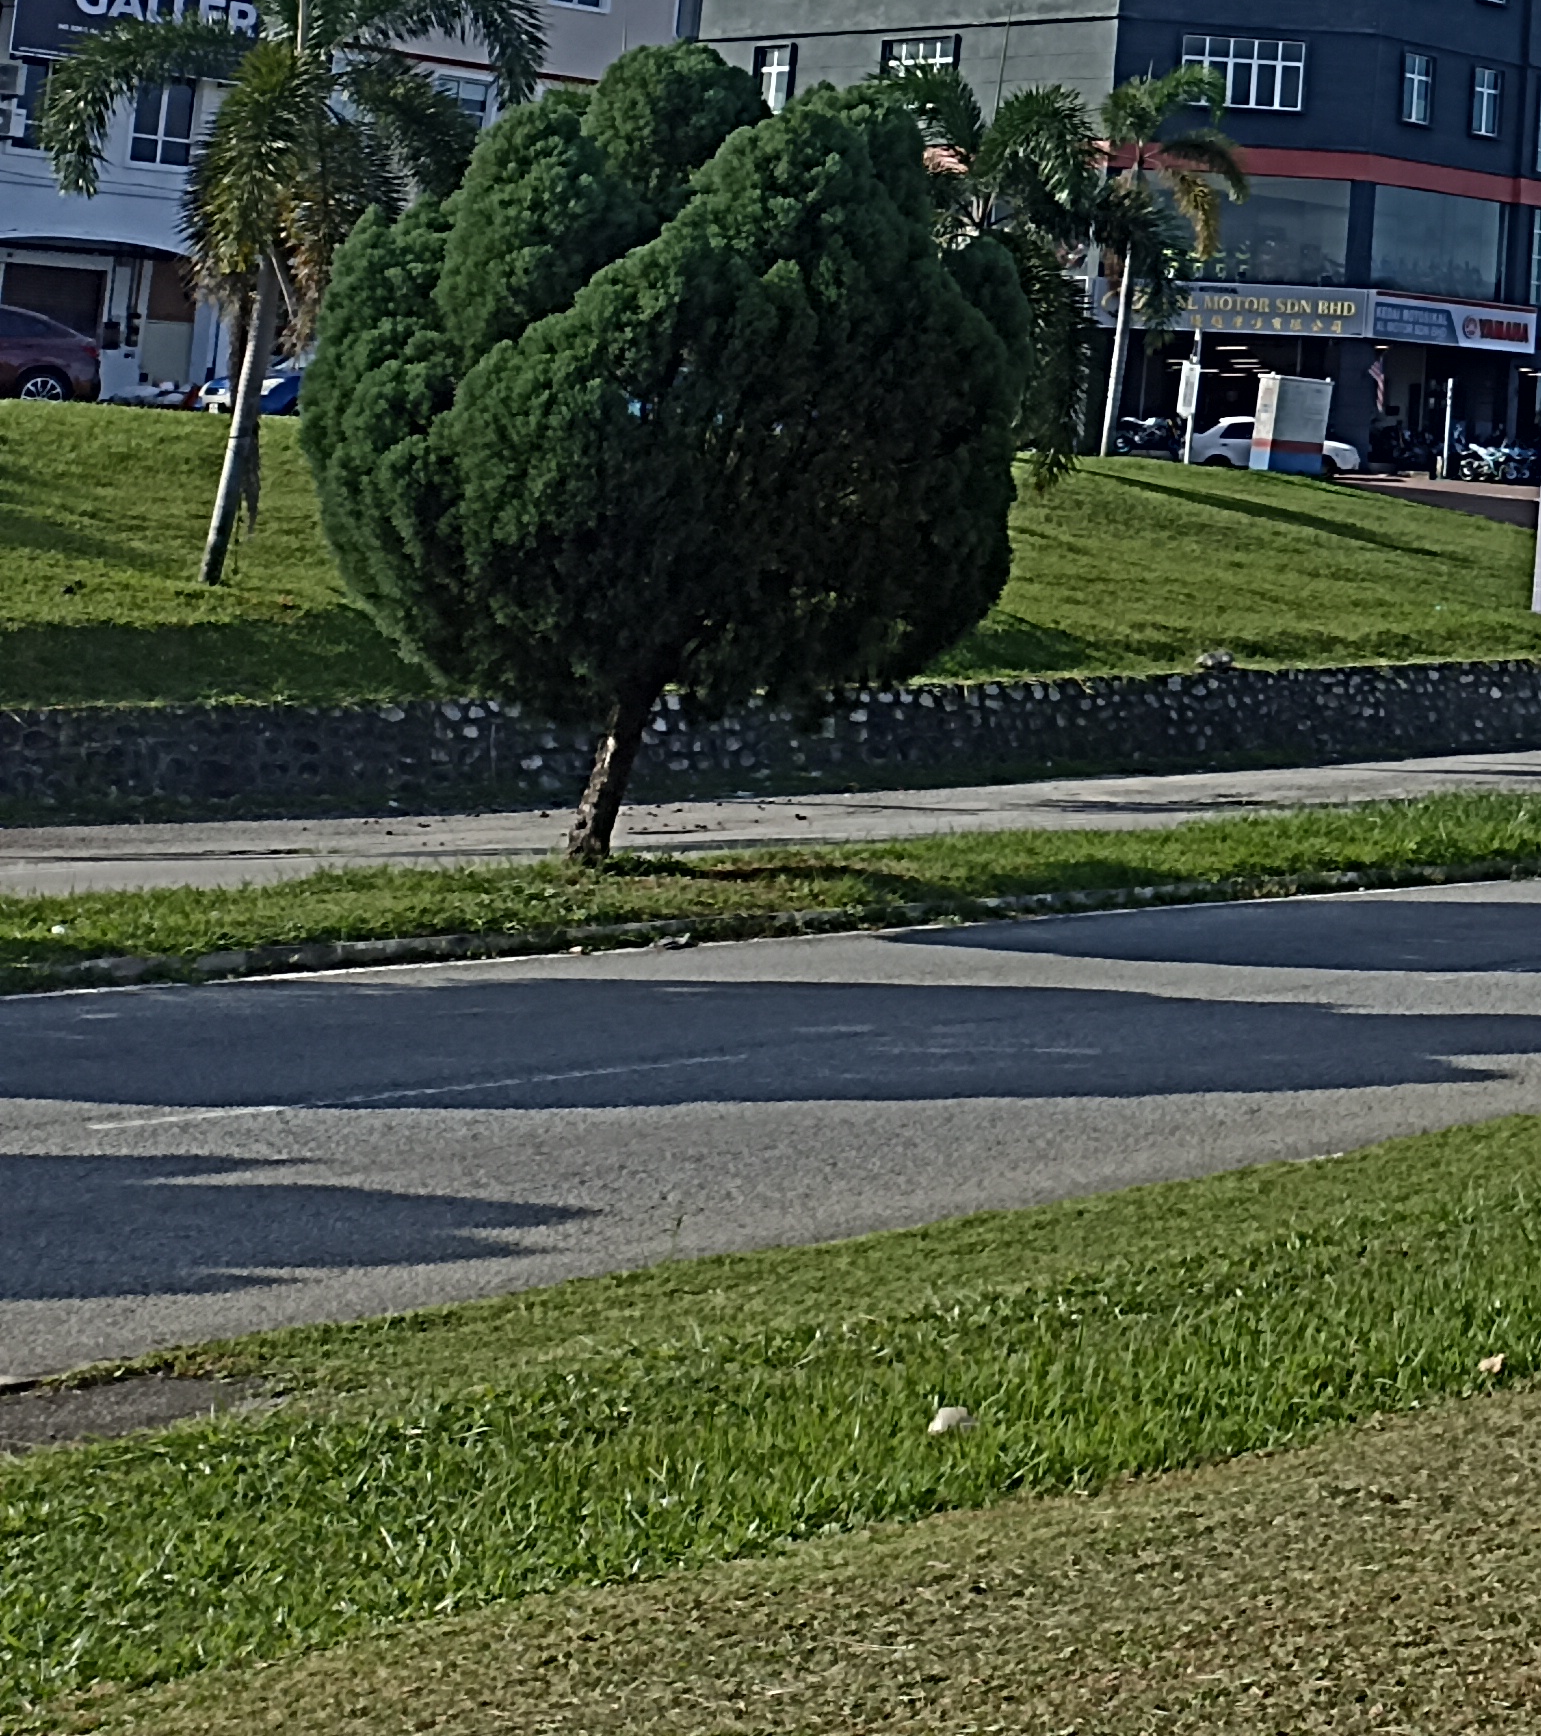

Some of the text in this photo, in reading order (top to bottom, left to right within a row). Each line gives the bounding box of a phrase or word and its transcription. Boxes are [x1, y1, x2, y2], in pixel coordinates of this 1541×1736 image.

[1204, 295, 1270, 312] MOTOR
[1275, 297, 1311, 314] SDN
[1317, 299, 1356, 316] BHD
[1480, 318, 1529, 343] YAMAHA
